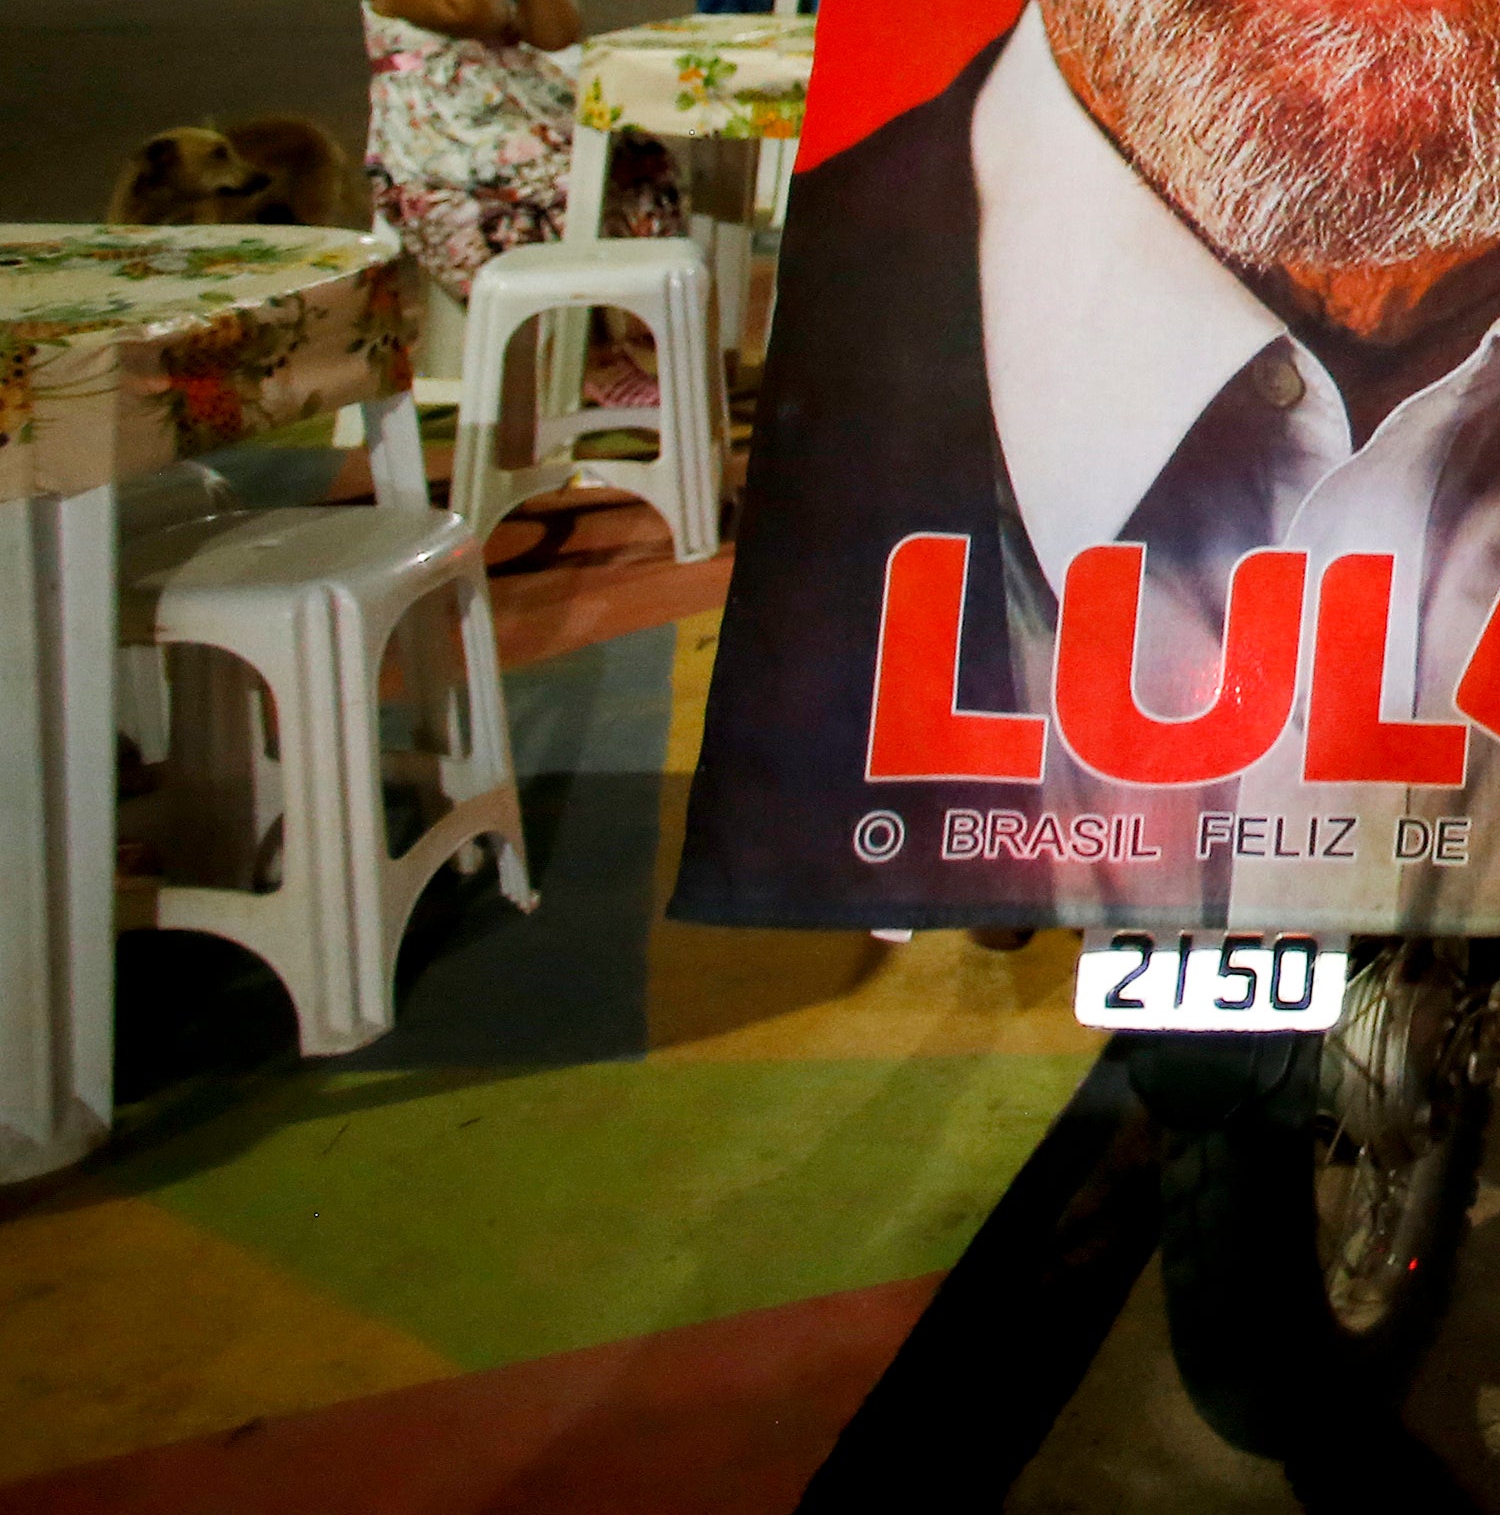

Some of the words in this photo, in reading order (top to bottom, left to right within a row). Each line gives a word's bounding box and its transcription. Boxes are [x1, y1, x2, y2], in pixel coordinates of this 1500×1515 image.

[853, 809, 906, 864] O
[941, 808, 1161, 863] BRASIL
[1196, 811, 1359, 864] FELIZ
[1394, 816, 1472, 867] DE
[1104, 929, 1317, 1010] 2150
